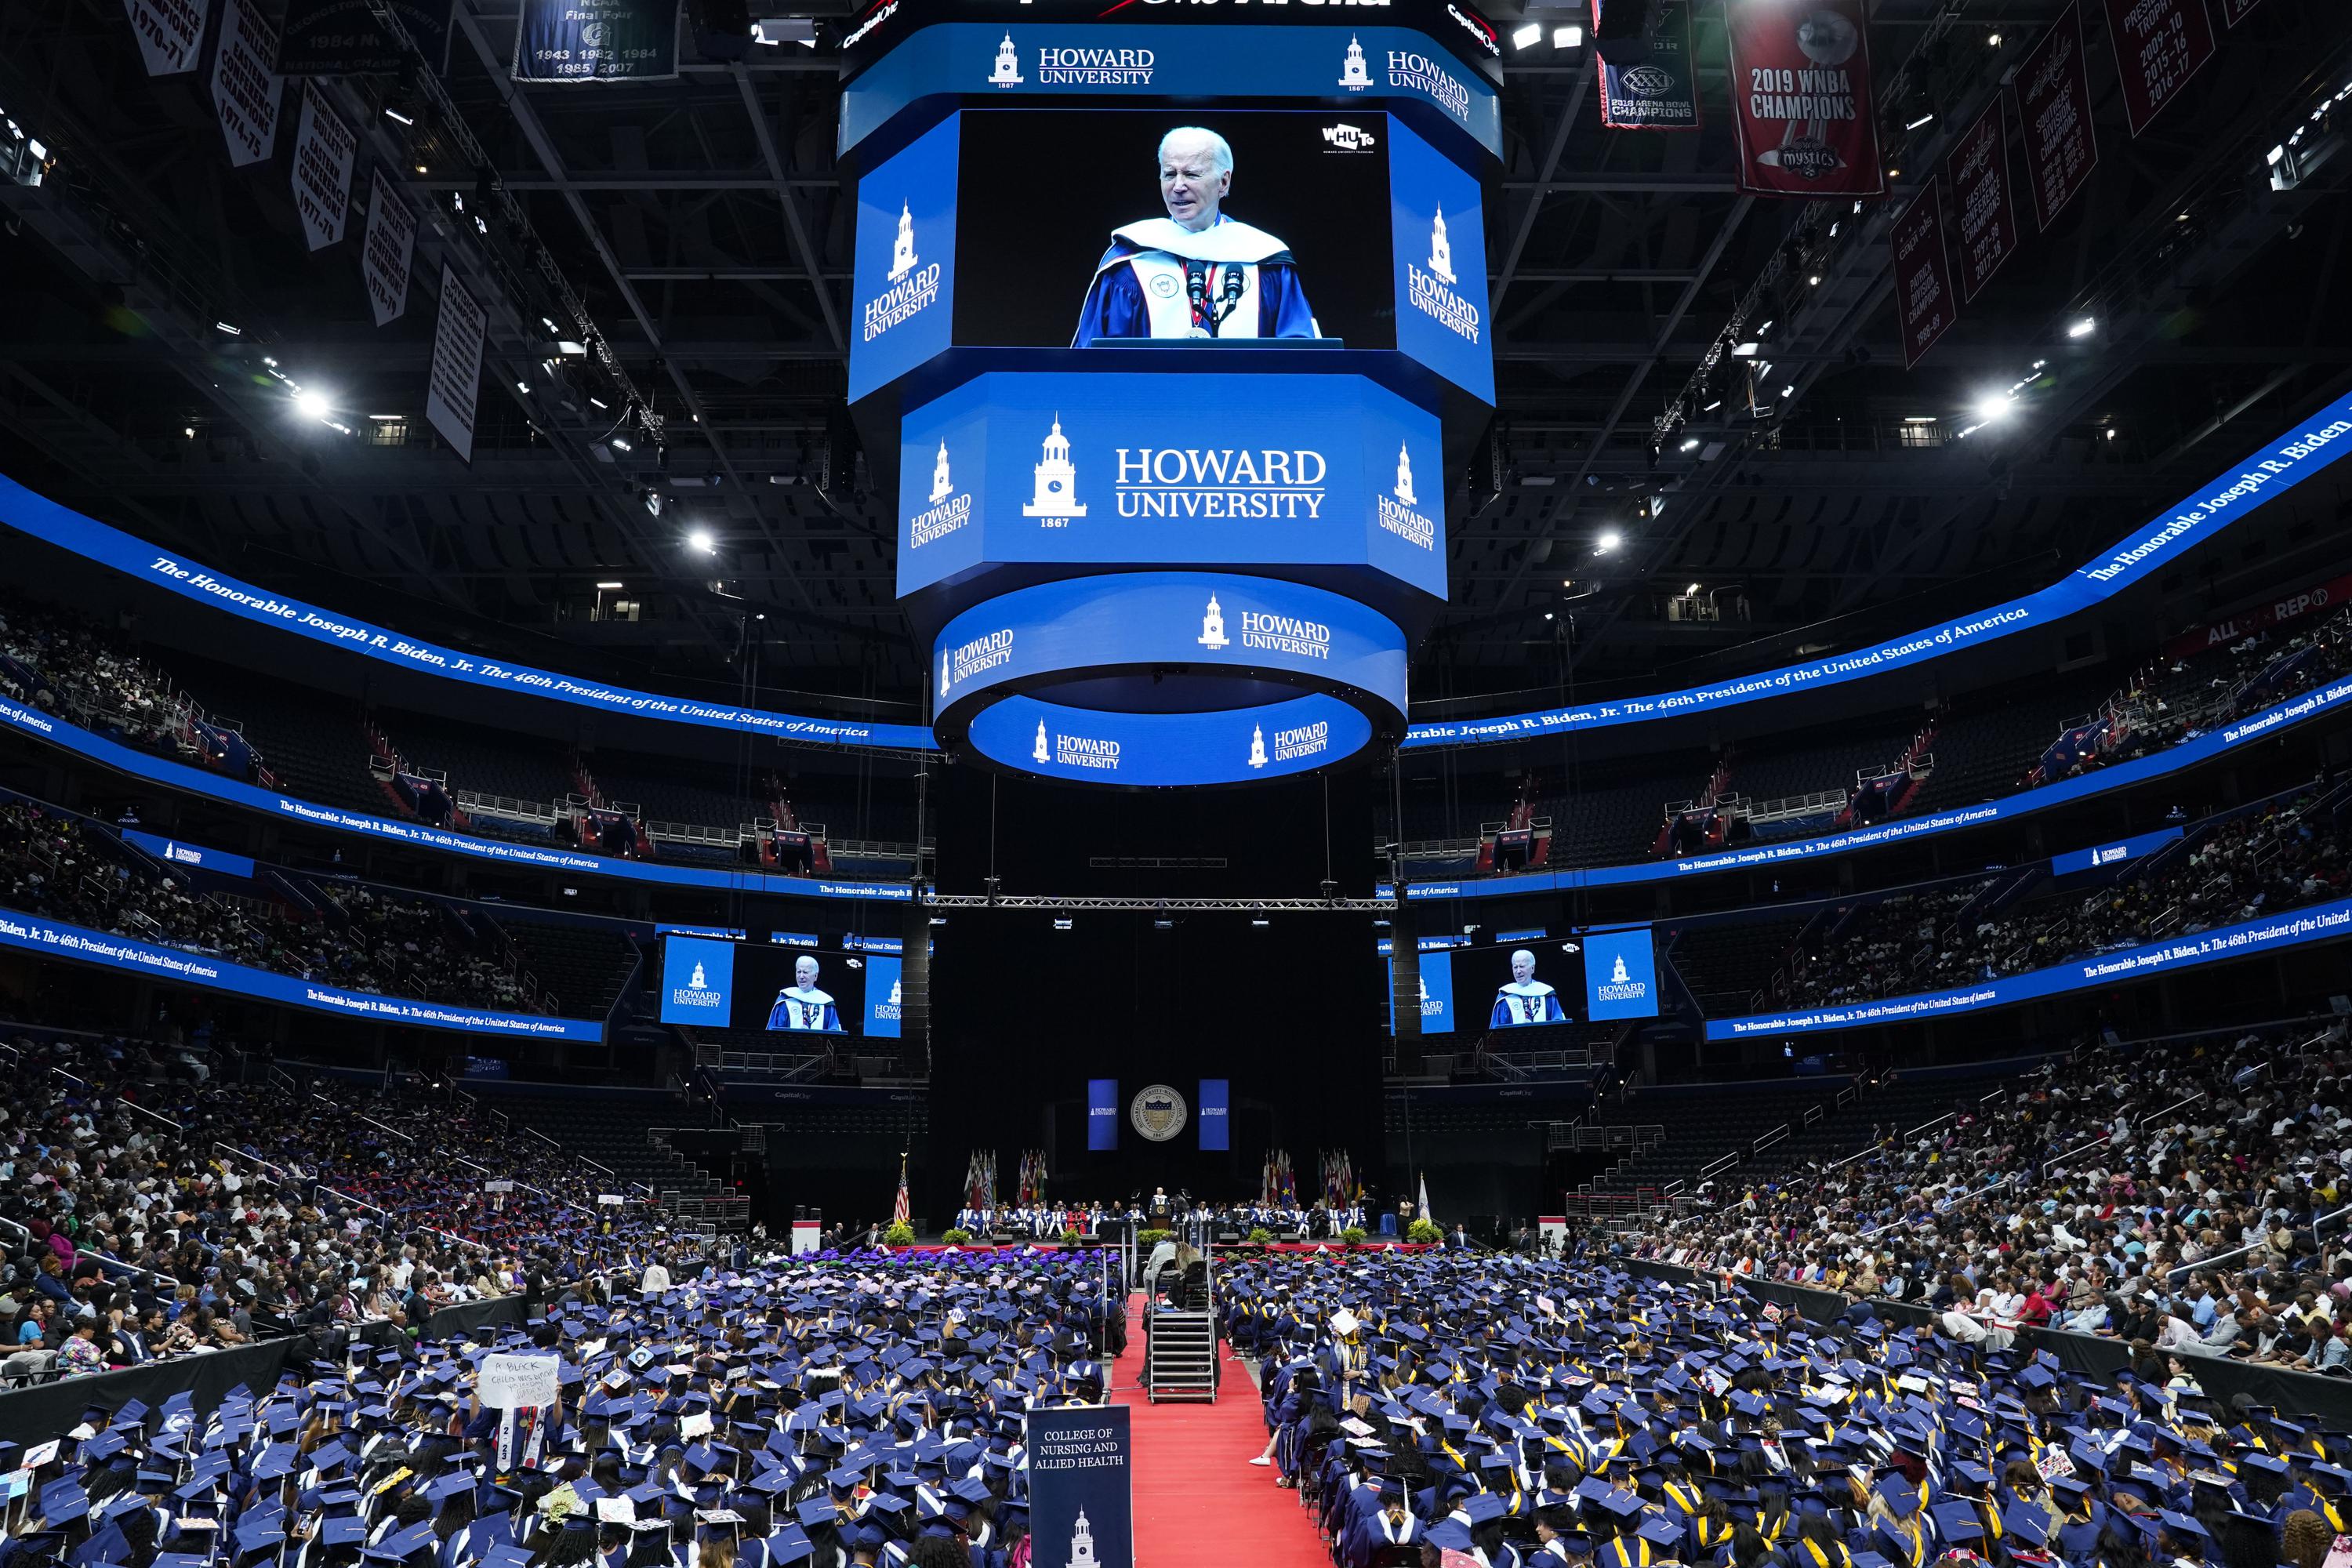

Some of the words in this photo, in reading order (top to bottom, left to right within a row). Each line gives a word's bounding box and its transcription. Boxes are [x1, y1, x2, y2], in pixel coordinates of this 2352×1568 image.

[565, 10, 598, 20] Final
[603, 10, 633, 20] Four
[536, 49, 570, 60] 1943
[579, 49, 614, 60] 1982
[622, 49, 657, 59] 1984
[2140, 10, 2183, 69] 2009-10
[234, 43, 269, 94] EASTERN
[599, 63, 633, 72] 2007
[1040, 48, 1154, 68] HOWARD
[2145, 35, 2187, 87] 2015-16
[222, 50, 274, 122] CONFERENCE
[1040, 71, 1152, 85] UNIVERSITY
[1387, 51, 1468, 104] HOWARD
[1751, 68, 1794, 93] 2019
[1798, 69, 1850, 94] WNBA
[2149, 53, 2190, 108] 2016-17
[220, 69, 269, 136] CHAMPIONS
[1388, 72, 1468, 122] UNIVERSITY
[1612, 107, 1692, 118] CHAMPIONS
[1750, 94, 1856, 120] CHAMPIONS
[220, 100, 260, 157] 1974-75
[306, 81, 356, 154] WASHINGTON
[314, 110, 343, 161] BULLETS
[300, 145, 345, 206] CONFERENCE
[310, 137, 339, 181] EASTERN
[299, 163, 341, 220] CHAMPIONS
[1961, 175, 2001, 233] CONFERENCE
[1966, 168, 1994, 209] EASTERN
[299, 191, 333, 241] 1977-78
[1965, 194, 2002, 245] CHAMPIONS
[865, 263, 940, 325] HOWARD
[894, 270, 909, 285] 1867
[1408, 263, 1479, 325] HOWARD
[1435, 272, 1449, 286] 1867
[864, 285, 938, 342] UNIVERSITY
[1409, 288, 1479, 344] UNIVERSITY
[1116, 448, 1327, 485] HOWARD
[911, 494, 971, 535] HOWARD
[1040, 518, 1069, 528] 1867
[1116, 493, 1325, 519] UNIVERSITY
[1378, 494, 1434, 536] HOWARD
[2087, 564, 2125, 581] The
[2114, 513, 2205, 565] Honorable
[2198, 473, 2271, 513] Joseph
[2258, 460, 2292, 473] R.
[911, 512, 970, 549] UNIVERSITY
[1379, 514, 1434, 551] UNIVERSITY
[1242, 612, 1330, 644] HOWARD
[2208, 619, 2240, 646] ALL
[151, 557, 189, 579] The
[187, 574, 296, 618] Honorable
[298, 613, 368, 641] Joseph
[369, 635, 388, 648] R.
[390, 642, 445, 667] Biden,
[451, 659, 473, 671] Jr.
[480, 665, 512, 678] The
[514, 673, 552, 687] 46th
[553, 681, 632, 703] President
[632, 699, 652, 709] of
[651, 702, 677, 711] the
[681, 705, 736, 720] United
[736, 714, 784, 728] States
[786, 723, 806, 731] of
[801, 724, 868, 736] America
[954, 629, 1014, 668] HOWARD
[1243, 633, 1329, 660] UNIVERSITY
[954, 649, 1013, 684] UNIVERSITY
[1461, 722, 1519, 737] Joseph
[1541, 713, 1596, 725] Biden,
[1600, 708, 1620, 717] Jr.
[1624, 703, 1653, 713] The
[1657, 696, 1695, 709] 46th
[1696, 680, 1773, 702] President
[1776, 673, 1791, 686] of
[1793, 670, 1820, 681] the
[1822, 653, 1882, 673] United
[1882, 639, 1933, 659] States
[1936, 630, 1952, 643] of
[1955, 609, 2028, 638] America
[1058, 735, 1120, 757] HOWARD
[1275, 721, 1328, 749] HOWARD
[1275, 737, 1327, 762] UNIVERSITY
[1058, 750, 1120, 770] UNIVERSITY
[281, 800, 294, 811] The
[295, 804, 339, 822] Honorable
[340, 815, 371, 829] Joseph
[372, 822, 381, 830] R.
[383, 824, 408, 837] Biden,
[409, 829, 419, 838] Jr.
[422, 832, 434, 841] The
[435, 836, 452, 845] 46th
[452, 839, 486, 851] President
[495, 848, 508, 856] the
[510, 849, 535, 859] United
[536, 853, 559, 862] States
[560, 857, 569, 866] of
[568, 858, 598, 868] America
[176, 848, 201, 859] HOWARD
[176, 855, 201, 864] UNIVERSITY
[2101, 846, 2127, 858] HOWARD
[2102, 852, 2126, 862] UNIVERSITY
[2084, 967, 2097, 977] The
[2097, 958, 2136, 975] Honorable
[2137, 952, 2164, 966] Joseph
[2164, 950, 2172, 960] R.
[2172, 946, 2199, 958] Biden,
[2201, 942, 2210, 953] Jr.
[2212, 938, 2227, 950] The
[2228, 933, 2247, 946] 46th
[2249, 925, 2288, 942] President
[2290, 920, 2300, 936] of
[2300, 919, 2315, 931] the
[2317, 909, 2350, 927] United
[673, 989, 720, 1000] HOWARD
[673, 997, 720, 1007] UNIVERSITY
[1598, 982, 1646, 995] HOWARD
[1599, 990, 1645, 1001] UNIVERSITY
[951, 1310, 964, 1320] HU
[492, 1375, 515, 1385] CHILD
[495, 1363, 502, 1372] A
[506, 1362, 540, 1372] BLACK
[1040, 1443, 1091, 1456] NURSING
[1094, 1441, 1118, 1454] AND
[1044, 1429, 1095, 1442] COLLEGE
[1098, 1428, 1112, 1439] OF
[1035, 1457, 1076, 1470] ALLIED
[1078, 1454, 1123, 1468] HEALTH
